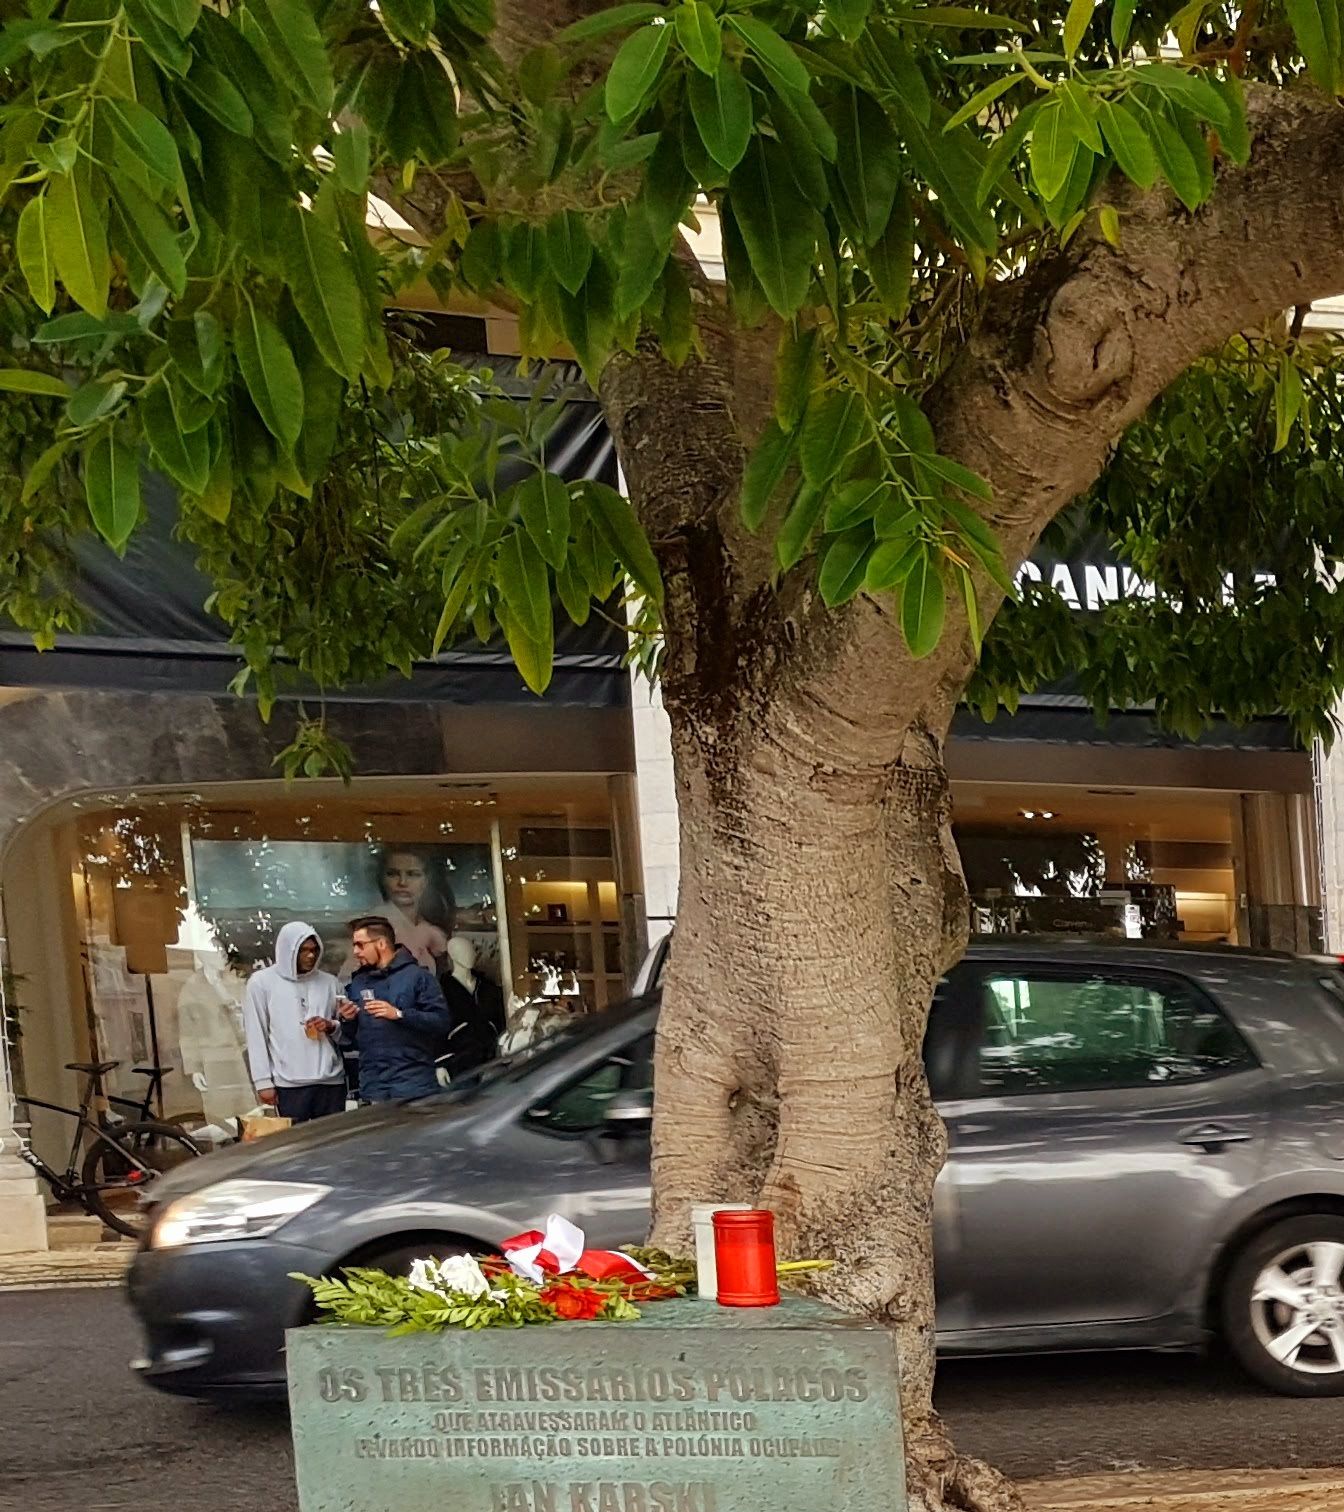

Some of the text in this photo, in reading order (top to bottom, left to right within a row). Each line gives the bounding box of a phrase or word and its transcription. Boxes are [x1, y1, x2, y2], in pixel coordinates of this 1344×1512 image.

[319, 1367, 368, 1402] OS
[375, 1360, 465, 1402] TRÊS
[705, 1366, 869, 1403] POLACOS
[433, 1407, 758, 1433] QUE ATRAVESSARAM O ATLÂNTICO
[355, 1438, 438, 1459] LEVANDO
[446, 1434, 571, 1460] INFORMAÇÃO
[577, 1437, 640, 1457] SOBRE
[645, 1438, 659, 1457] A
[662, 1433, 744, 1457] POLÓNIA
